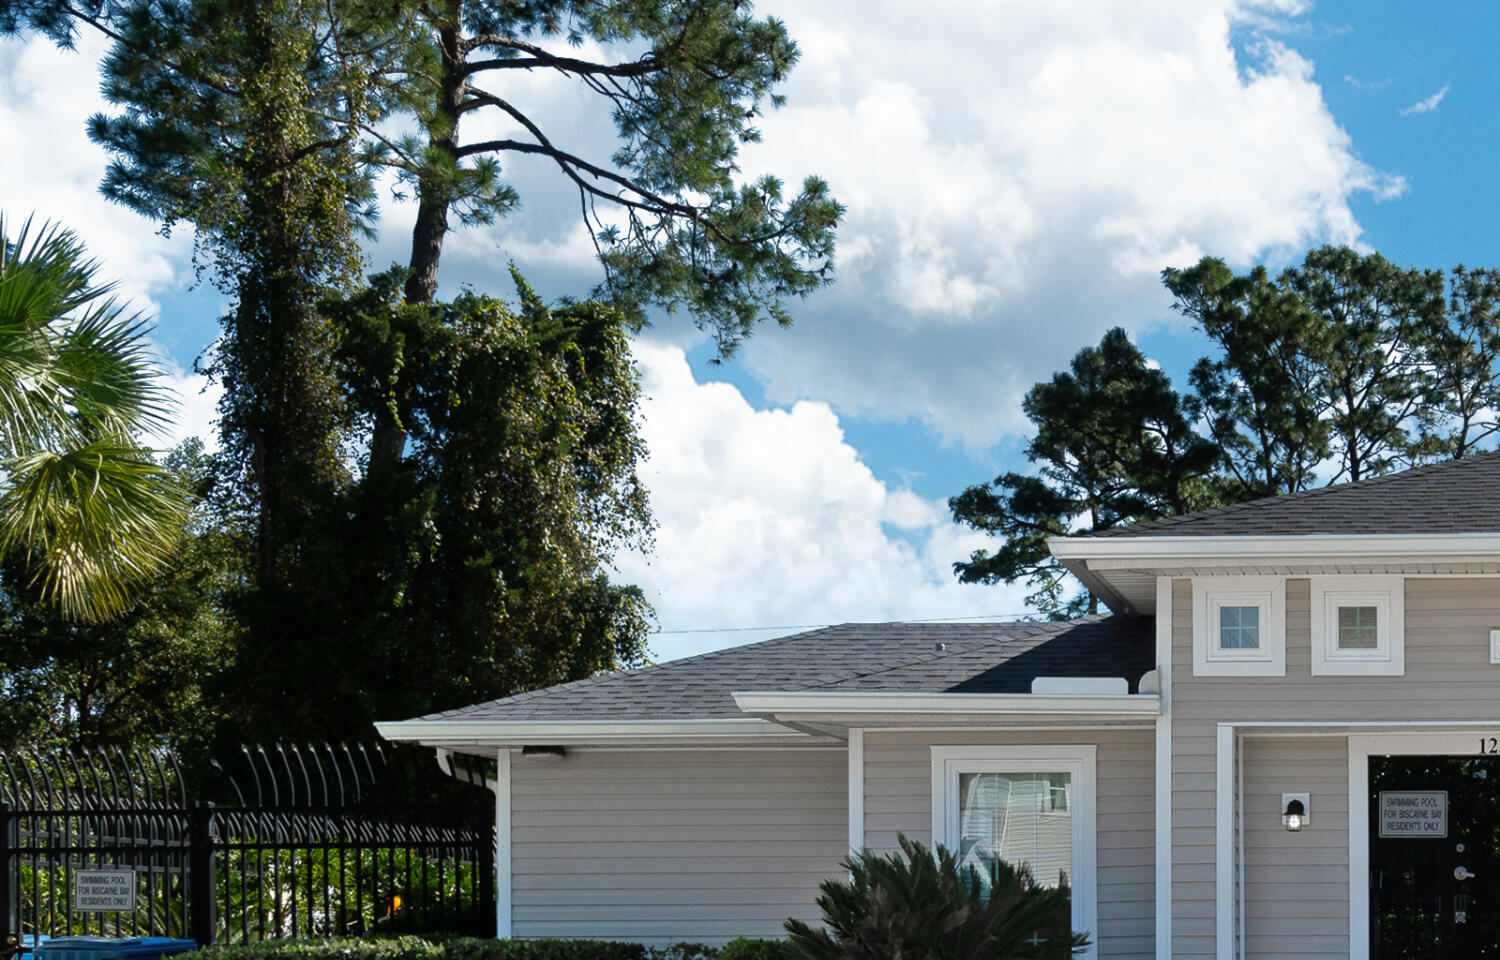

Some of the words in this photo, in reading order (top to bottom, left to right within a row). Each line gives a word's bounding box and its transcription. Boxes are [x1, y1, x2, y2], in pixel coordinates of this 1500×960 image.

[1387, 798, 1419, 807] SWIMMING
[1421, 798, 1438, 807] POOL
[1384, 809, 1397, 819] FOR
[1399, 809, 1429, 819] BISCAYNE
[1431, 809, 1443, 819] BAY
[1387, 821, 1421, 831] RESIDENTS
[1423, 821, 1440, 831] ONLY
[80, 875, 110, 884] SWIMMING
[111, 876, 126, 884] POOL
[78, 886, 90, 895] FOR
[92, 886, 119, 895] BISCAYNE
[120, 886, 130, 895] BAY
[80, 897, 112, 905] RESIDENTS
[113, 897, 127, 906] ONLY
